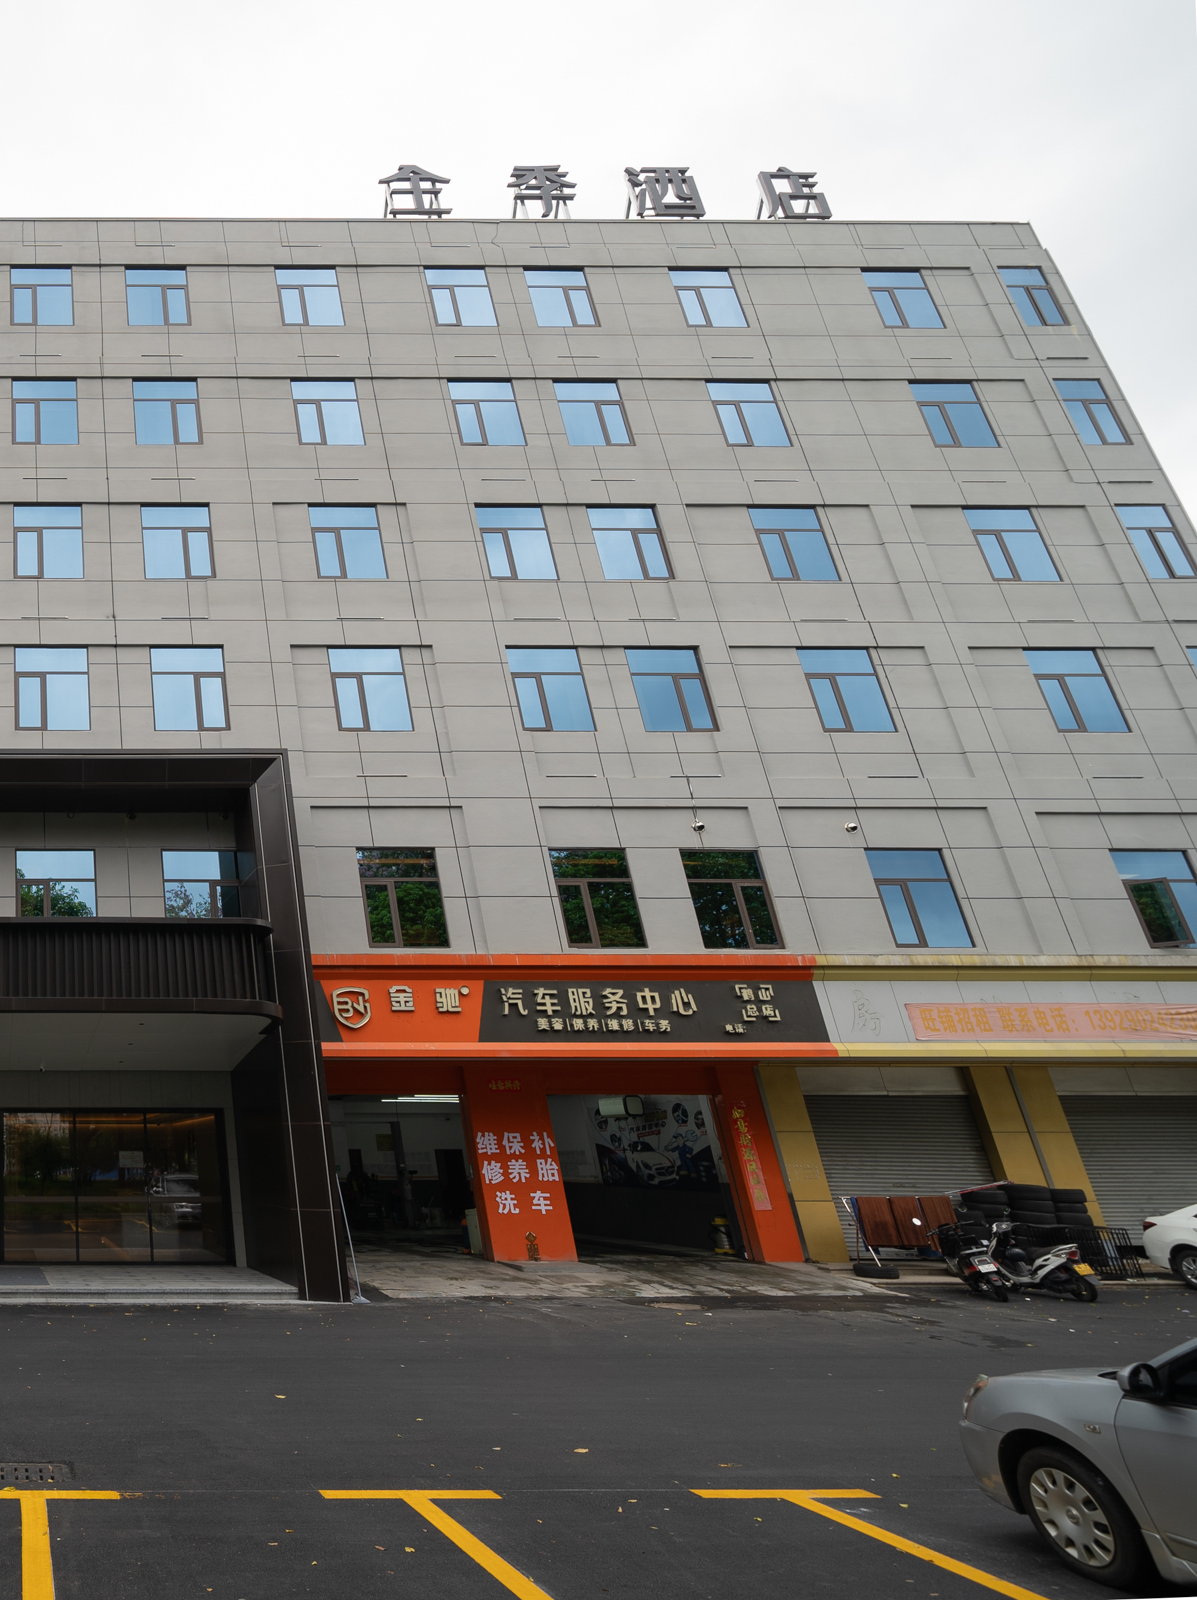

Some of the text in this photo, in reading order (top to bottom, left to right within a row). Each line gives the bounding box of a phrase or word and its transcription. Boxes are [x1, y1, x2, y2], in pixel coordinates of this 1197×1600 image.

[378, 165, 832, 219] 全季酒店
[388, 985, 462, 1012] 金驰
[500, 987, 698, 1016] 汽车服务中心
[740, 988, 772, 1001] 鹤山
[747, 1004, 775, 1017] 总店
[918, 1006, 994, 1034] 旺铺招租
[495, 1190, 554, 1215] 洗车
